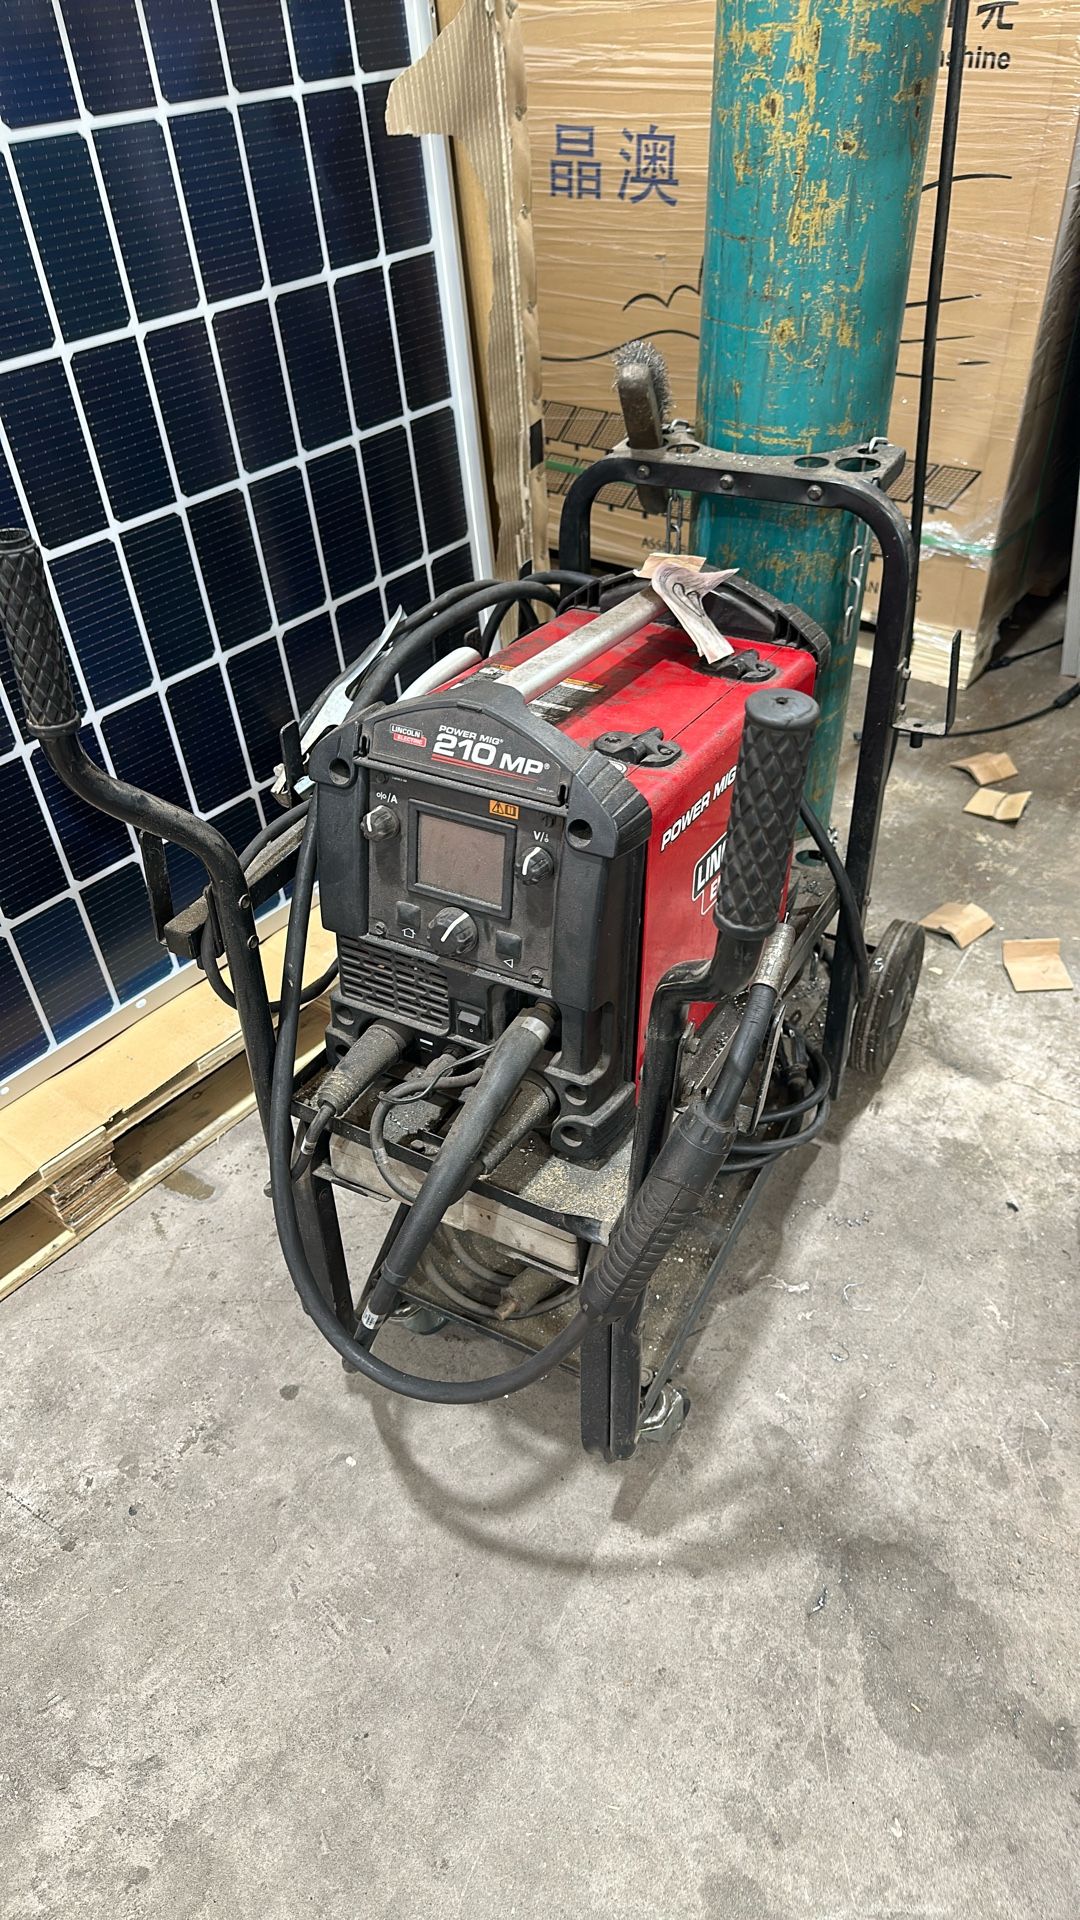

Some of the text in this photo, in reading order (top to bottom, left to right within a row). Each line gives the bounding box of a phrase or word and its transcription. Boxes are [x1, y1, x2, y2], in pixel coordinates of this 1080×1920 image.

[550, 124, 679, 207] 晶澳
[391, 725, 421, 739] LINCOLN
[397, 734, 424, 746] ELECTRIC
[438, 725, 478, 740] POWER
[433, 733, 497, 766] 210
[660, 790, 711, 852] POWER
[697, 839, 727, 892] LIN
